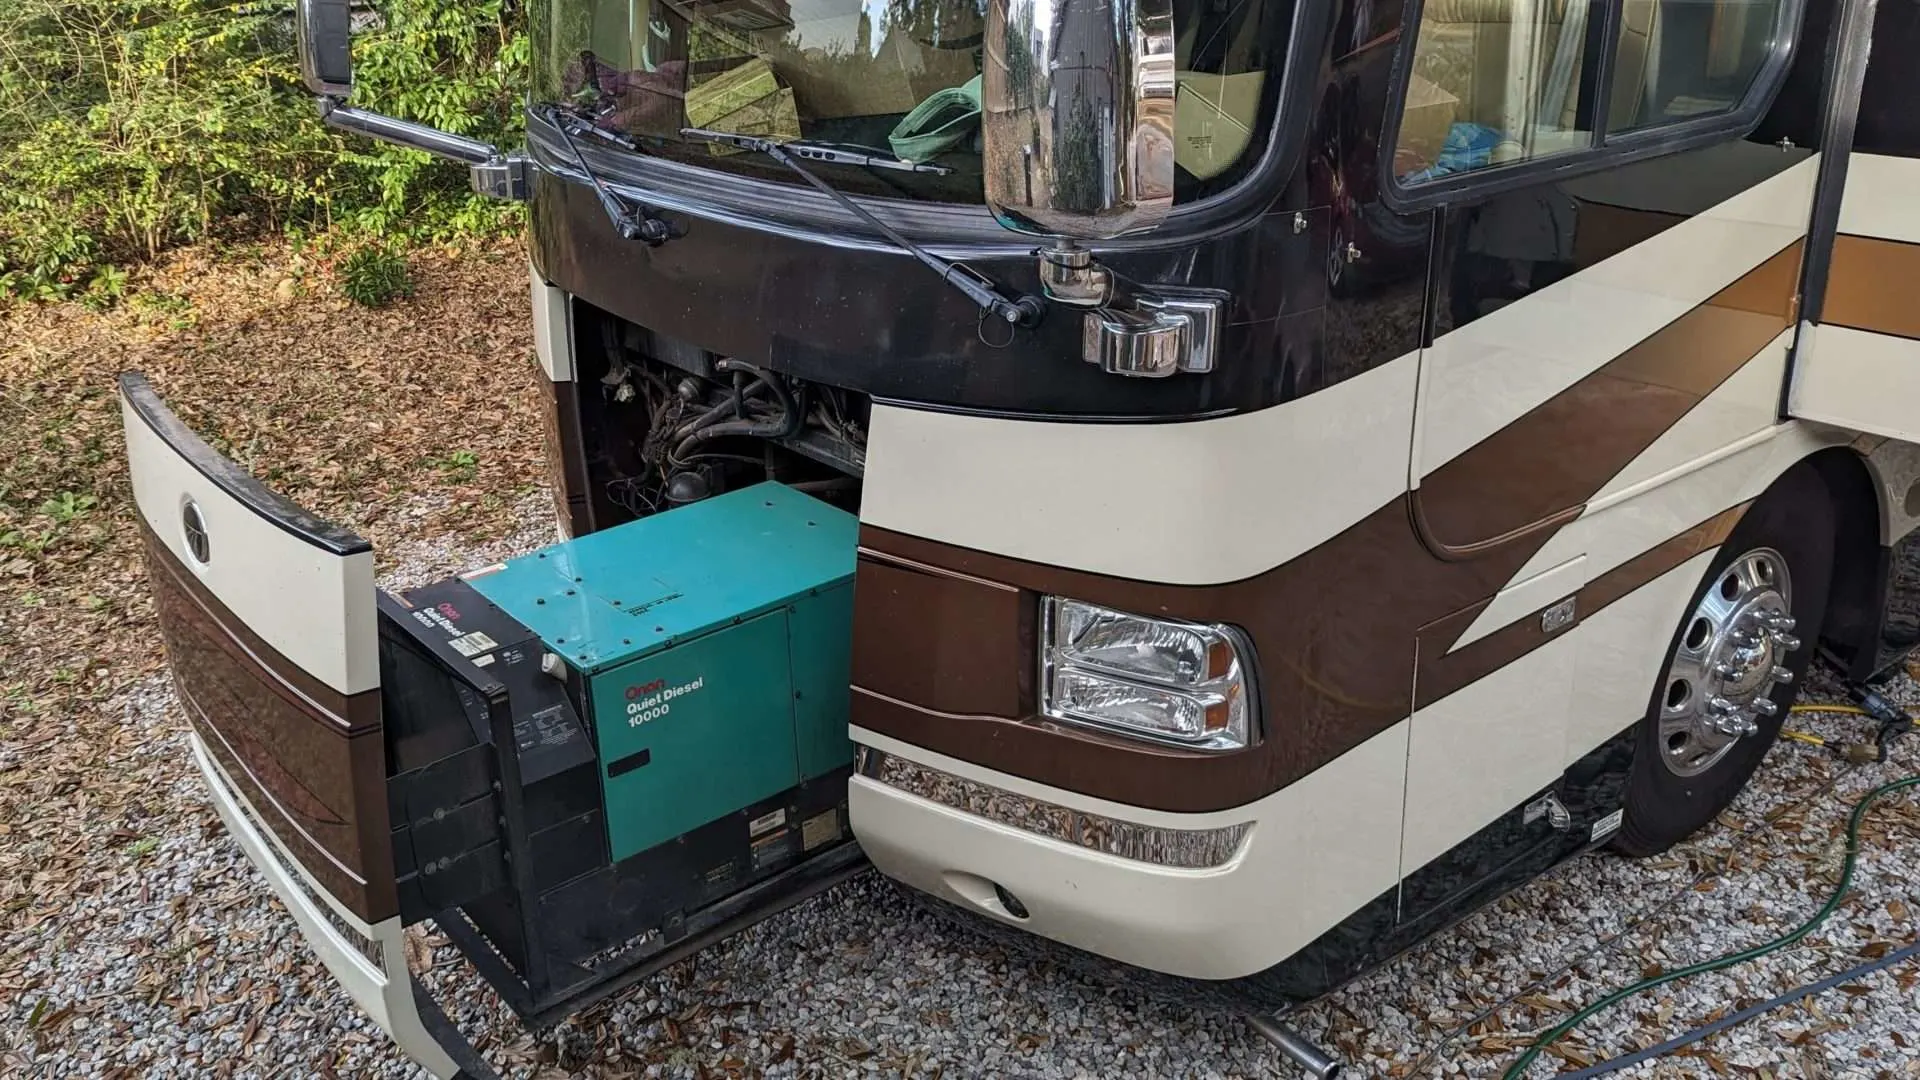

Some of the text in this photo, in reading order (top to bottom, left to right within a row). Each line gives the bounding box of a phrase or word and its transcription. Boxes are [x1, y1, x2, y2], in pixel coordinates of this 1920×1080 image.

[412, 611, 435, 628] 10000
[423, 607, 466, 637] Quiet Diesel
[625, 678, 664, 699] Onan
[627, 676, 703, 714] Quiet Diesel
[628, 704, 669, 728] 10000
